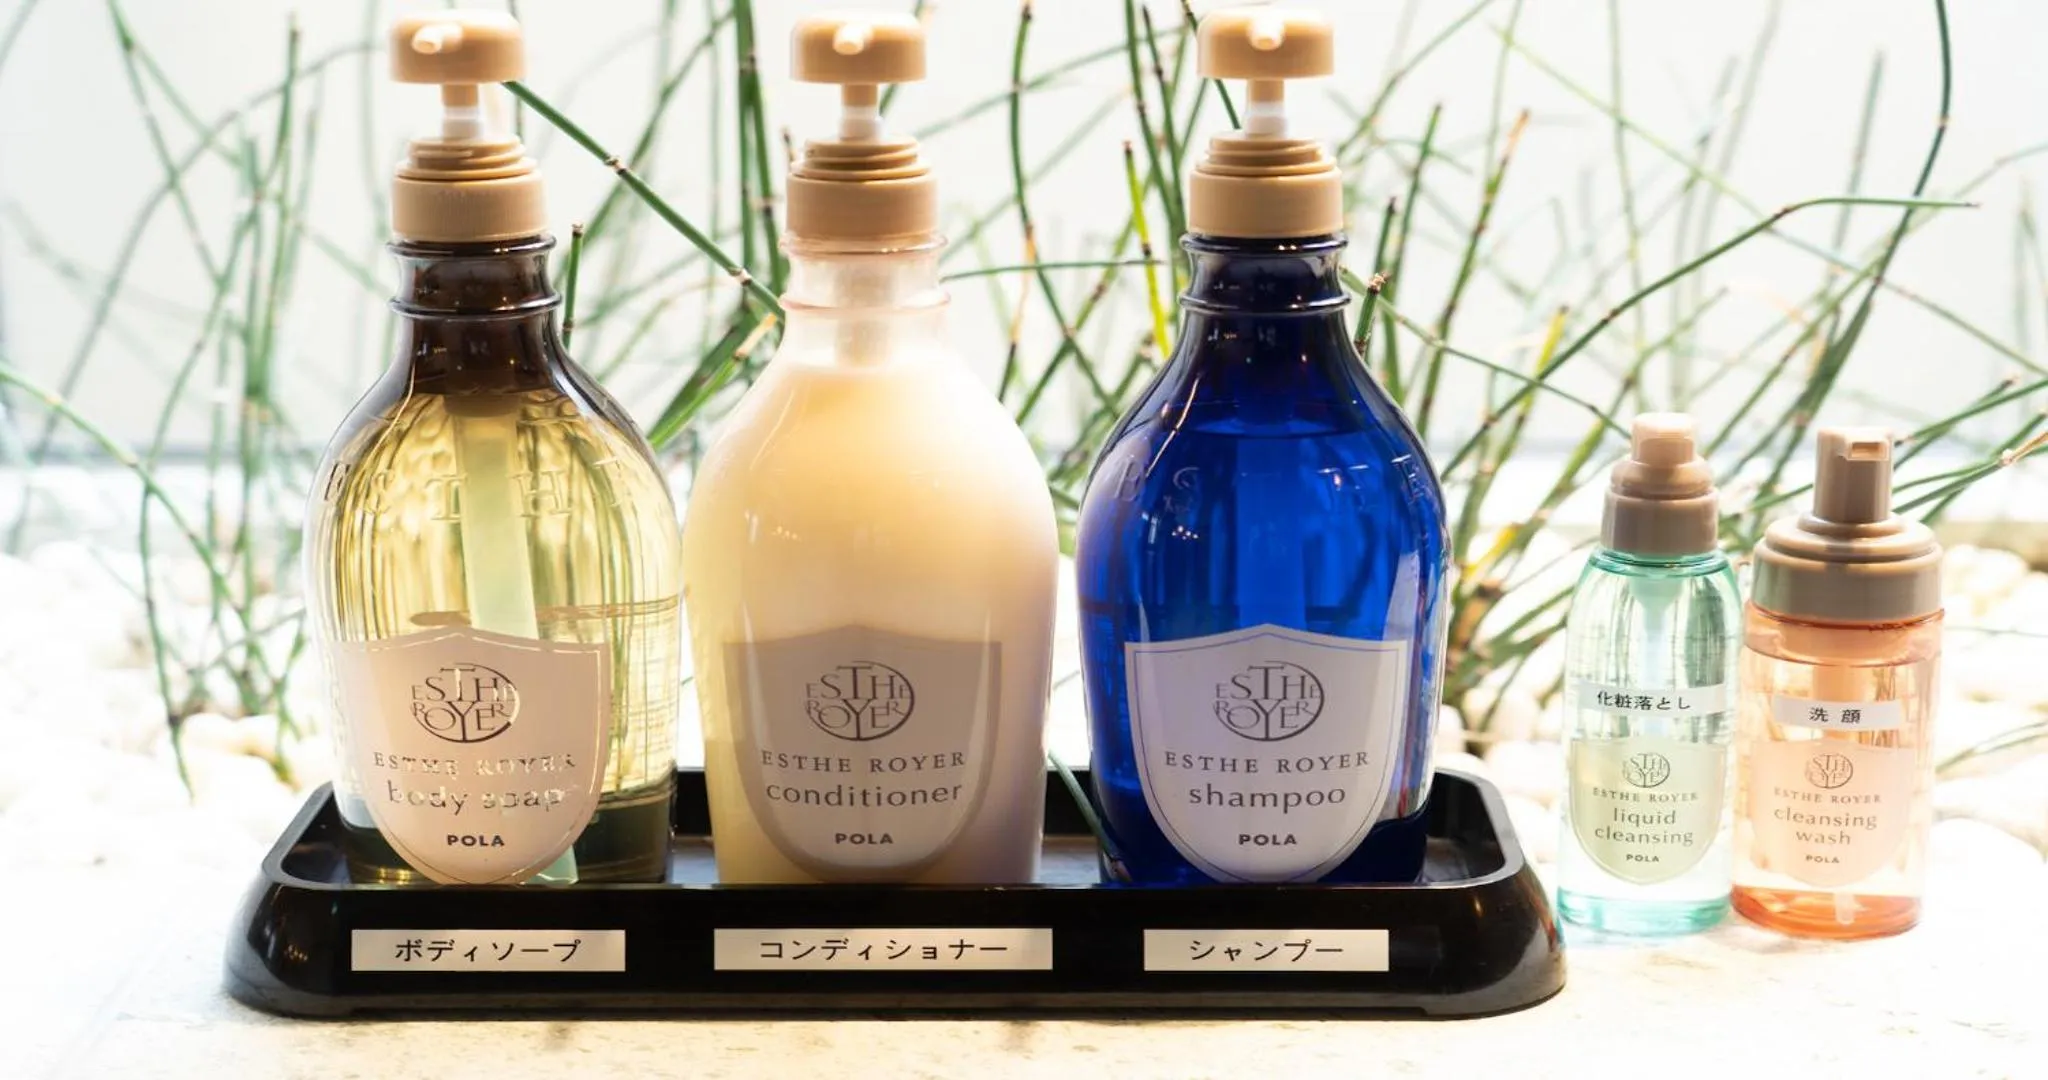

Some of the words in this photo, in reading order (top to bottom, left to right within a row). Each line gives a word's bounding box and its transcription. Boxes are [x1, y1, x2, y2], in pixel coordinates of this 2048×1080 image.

[1597, 691, 1691, 710] 化粧落とし
[761, 750, 852, 773] ESTHE
[870, 751, 966, 773] ROYER
[1165, 751, 1259, 774] ESTHE
[1277, 751, 1370, 774] ROYER
[387, 779, 468, 815] body
[483, 788, 566, 812] soap
[766, 784, 963, 807] conditioner
[1190, 784, 1346, 814] shampoo
[1593, 787, 1641, 802] ESTHE
[1649, 791, 1699, 802] ROYER
[1774, 787, 1822, 803] ESTHE
[1831, 794, 1881, 804] ROYER
[1613, 807, 1676, 827] liquid
[1774, 807, 1877, 830] cleansing
[447, 835, 505, 847] POLA
[835, 833, 894, 845] POLA
[1238, 834, 1297, 846] POLA
[1595, 826, 1694, 846] cleansing
[1795, 831, 1851, 845] wash
[1626, 854, 1659, 862] POLA
[1805, 855, 1839, 863] POLA
[395, 939, 582, 962] ボディソープ
[760, 938, 1008, 960] コンディショナー
[1189, 938, 1344, 962] シャンプー
